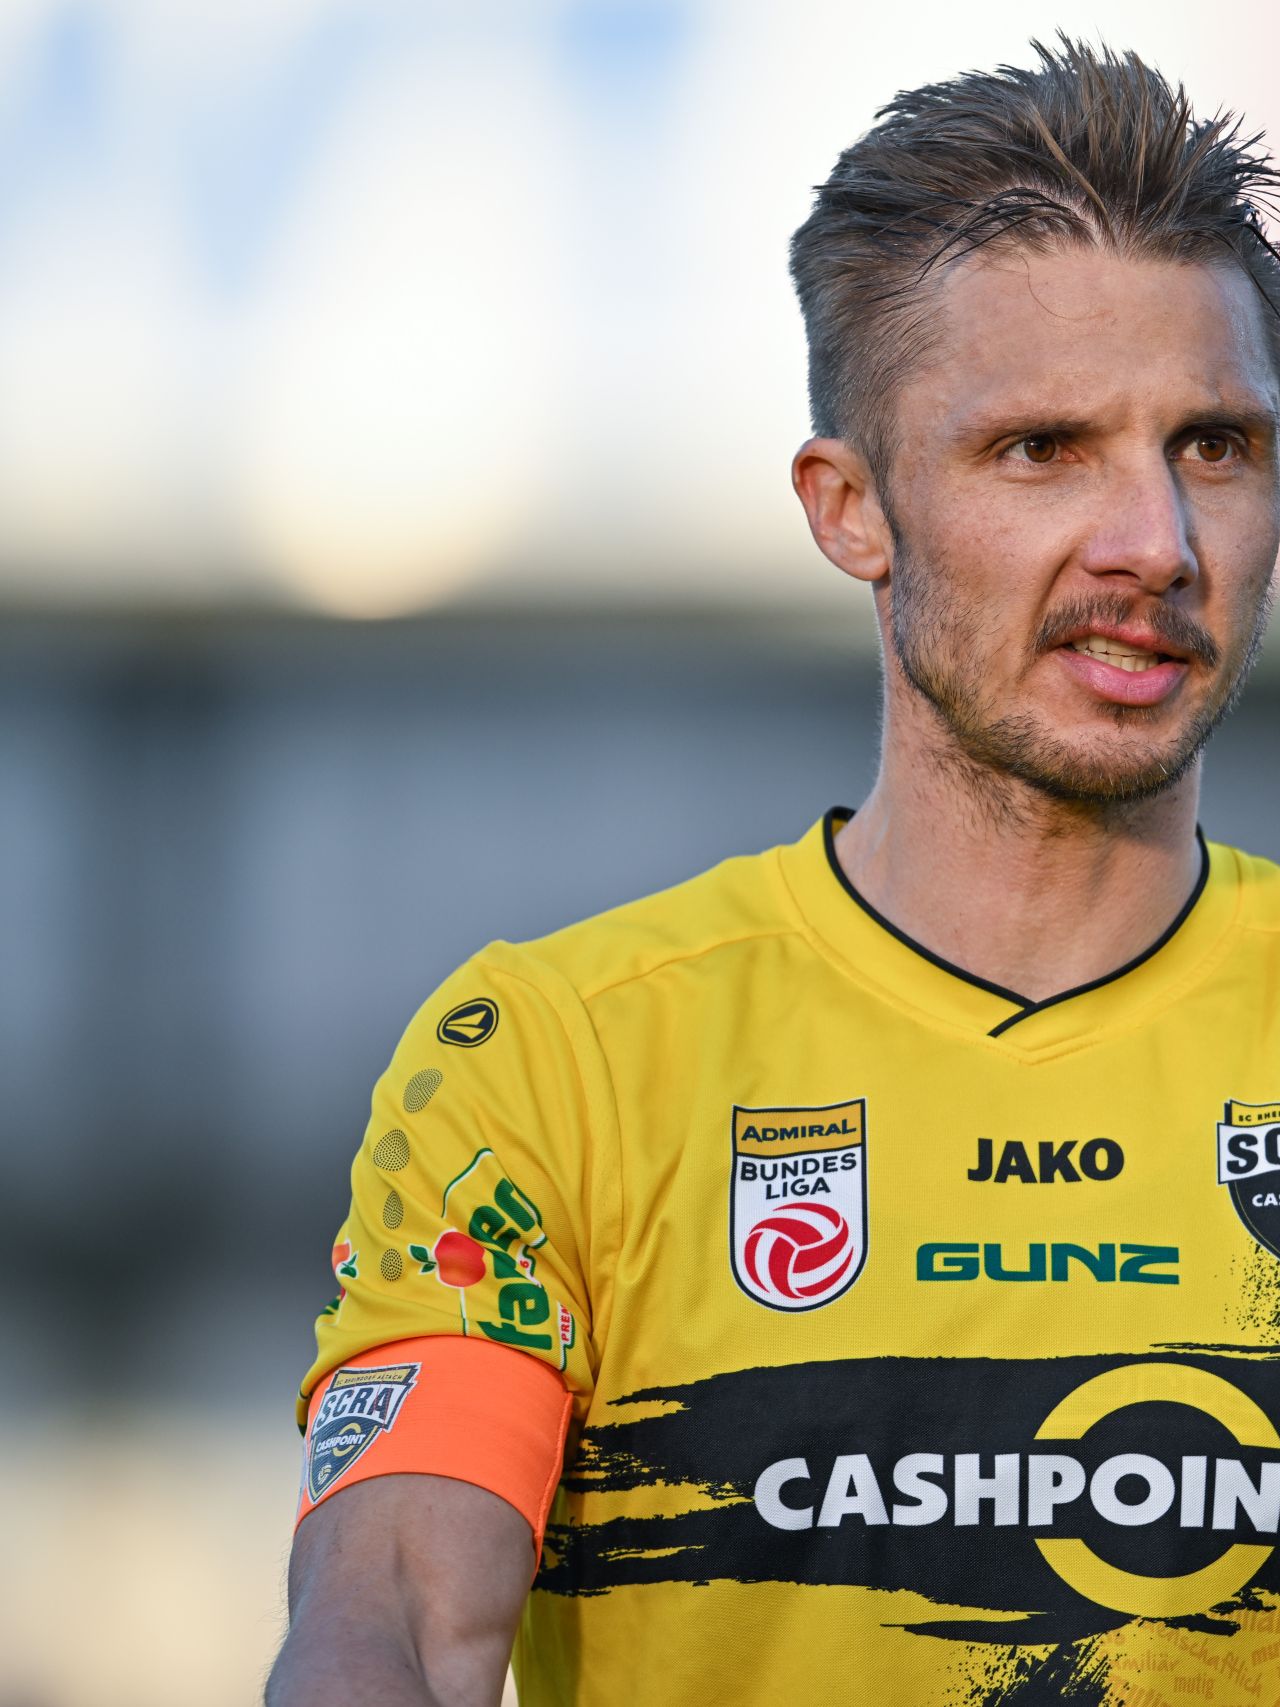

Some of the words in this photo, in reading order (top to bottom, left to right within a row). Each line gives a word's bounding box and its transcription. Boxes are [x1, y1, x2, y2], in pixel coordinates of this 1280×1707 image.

[741, 1119, 857, 1143] ADMIRAL
[740, 1152, 857, 1181] BUNDES
[967, 1137, 1124, 1184] JAKO
[765, 1176, 831, 1200] LIGA
[916, 1242, 1180, 1285] GUNZ
[316, 1387, 395, 1428] SCRA
[316, 1434, 366, 1453] CASHPOINT
